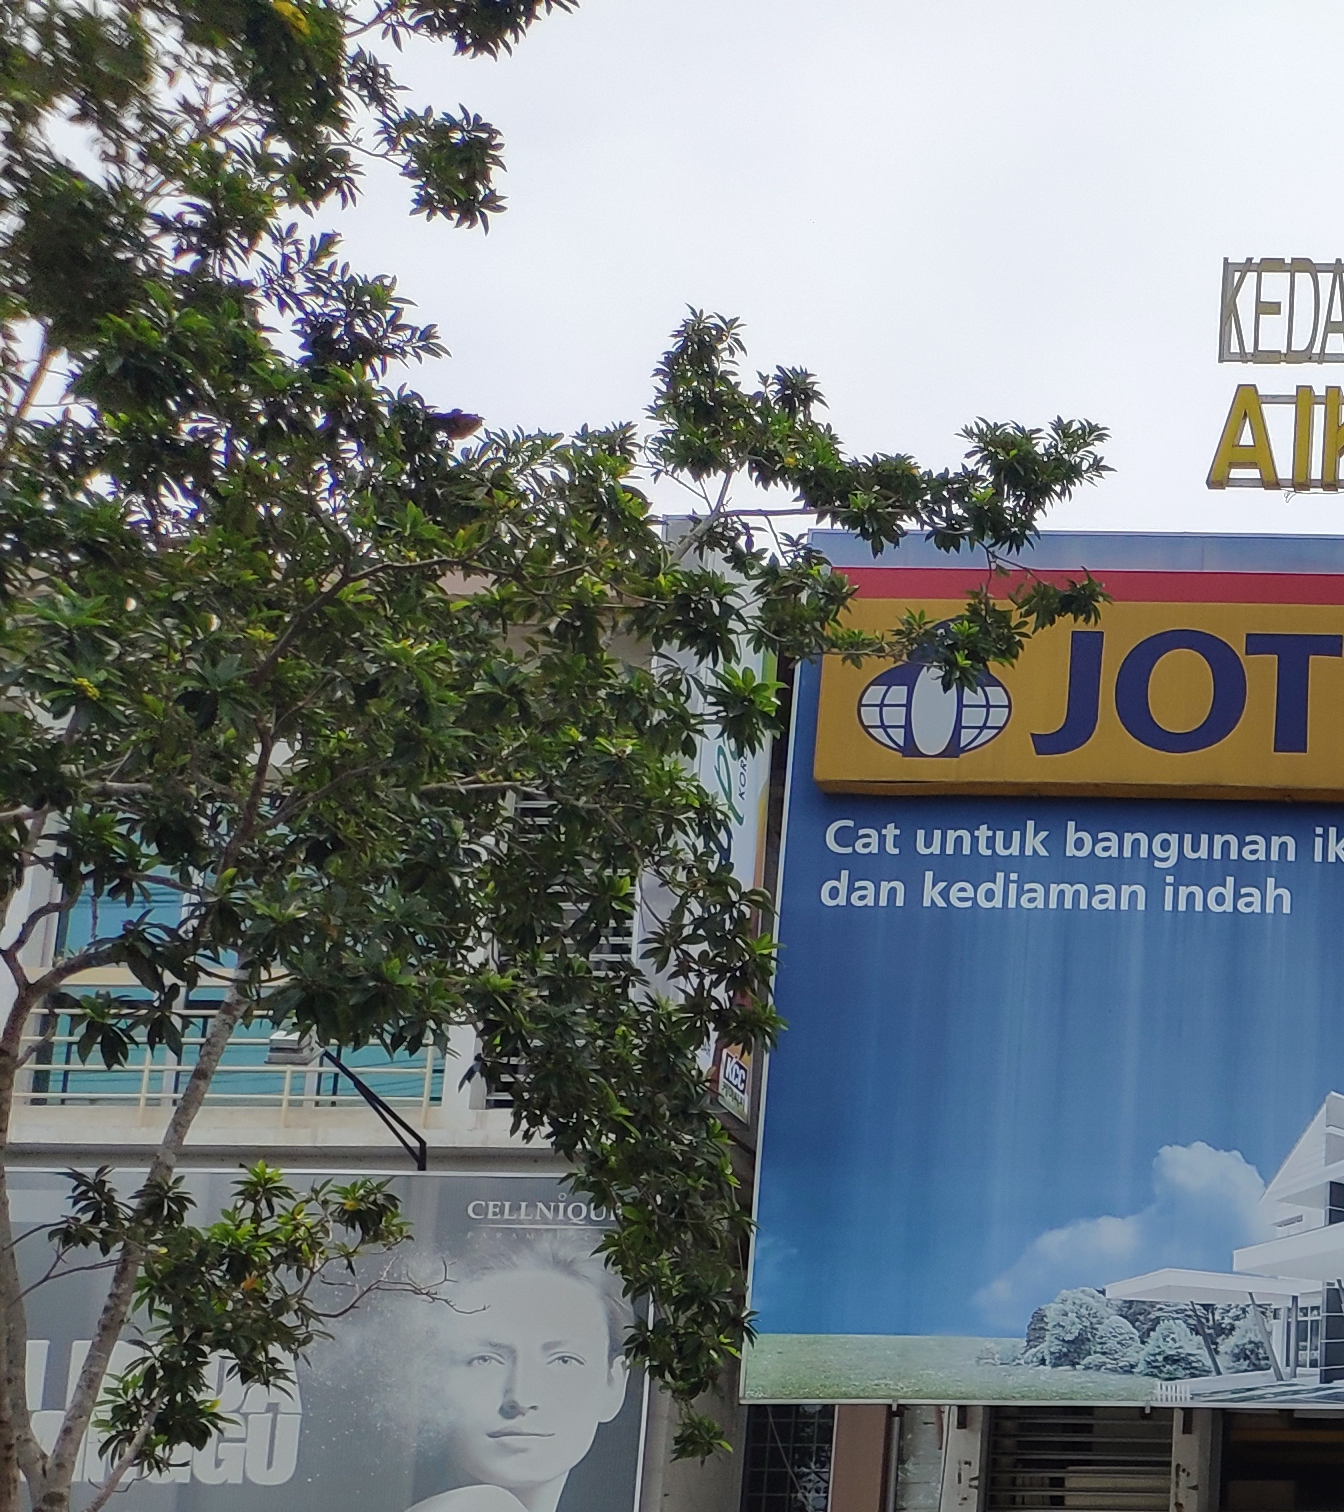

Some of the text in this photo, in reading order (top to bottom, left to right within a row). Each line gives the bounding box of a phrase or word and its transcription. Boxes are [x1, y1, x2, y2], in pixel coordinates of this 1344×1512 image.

[825, 818, 901, 856] Cat
[915, 819, 1050, 859] untuk
[1065, 822, 1296, 870] bangunan
[820, 870, 1292, 916] dan kediaman indah
